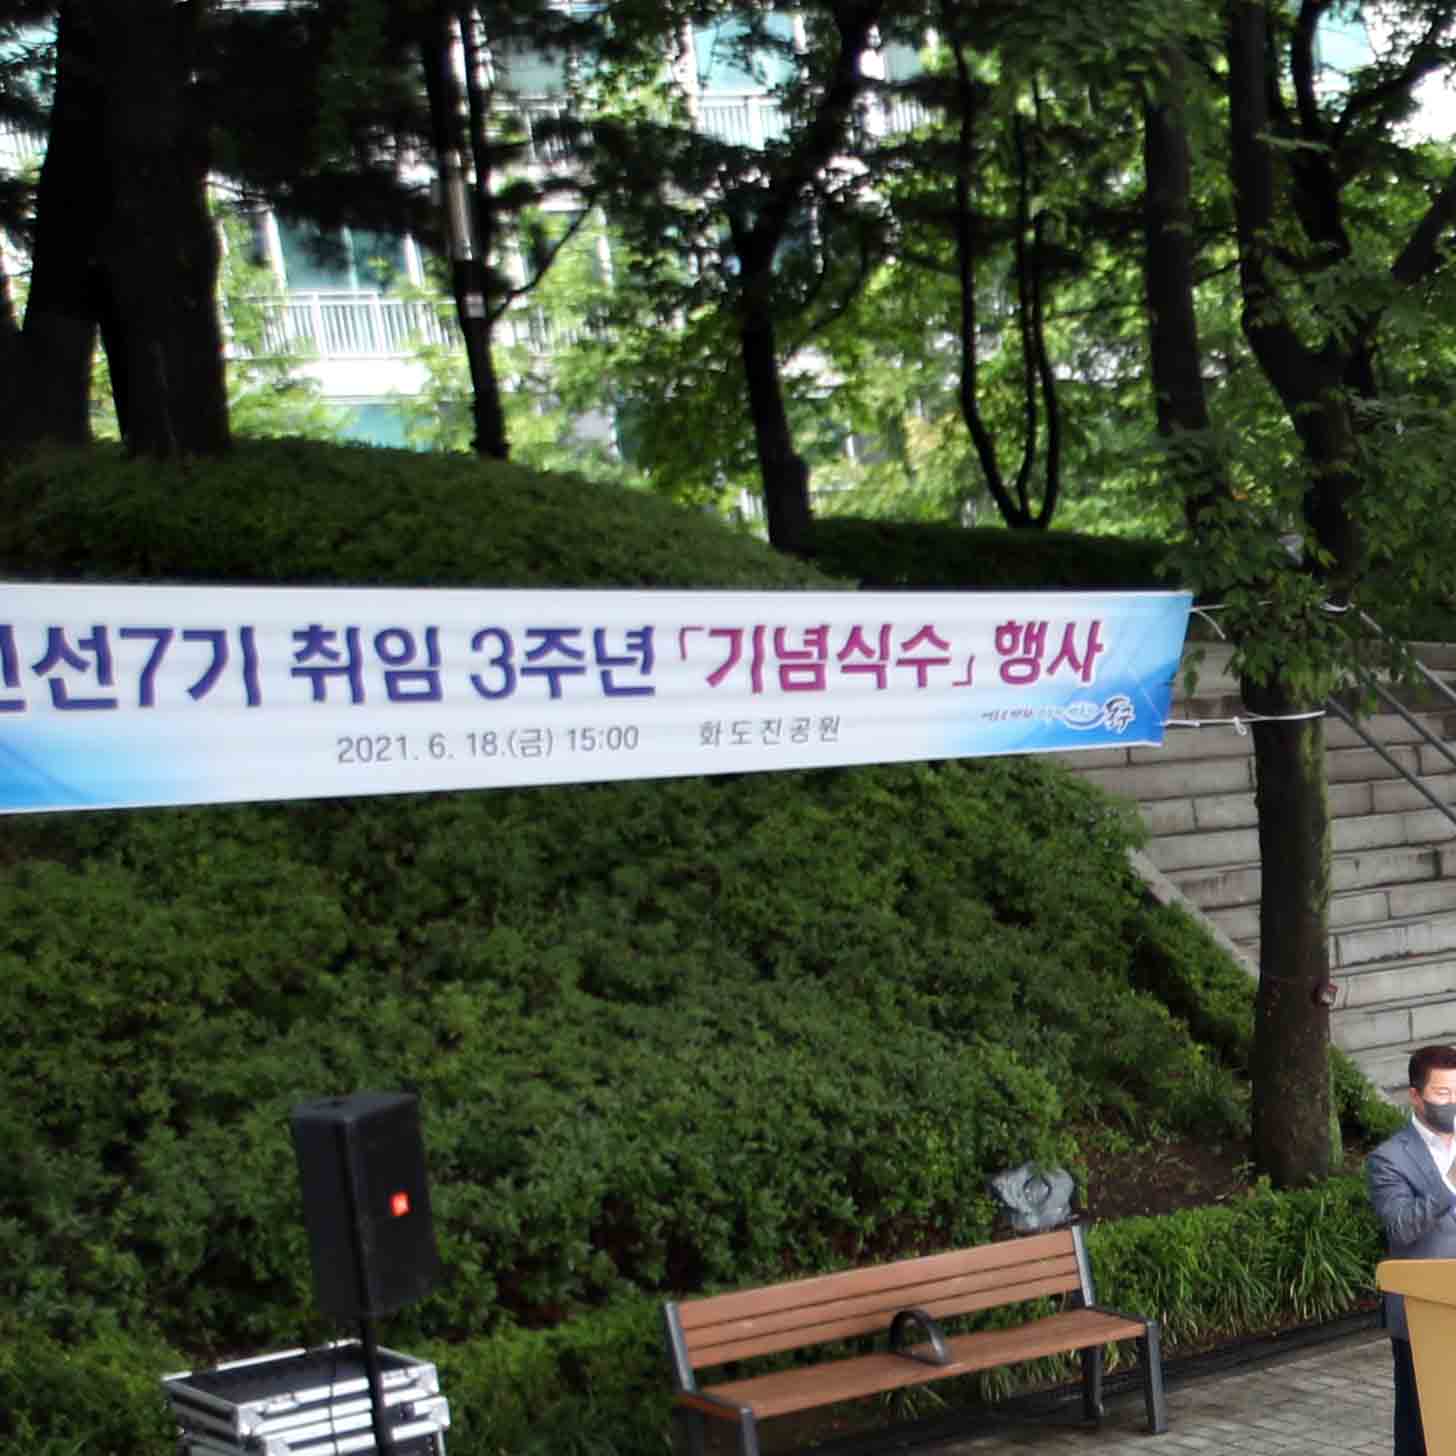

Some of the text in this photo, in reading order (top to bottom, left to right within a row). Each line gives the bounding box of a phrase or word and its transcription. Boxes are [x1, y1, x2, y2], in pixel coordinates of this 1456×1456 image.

[290, 623, 444, 705] 취임
[469, 624, 655, 701] 3주년
[679, 622, 976, 694] 「기념식수」
[994, 618, 1105, 685] 행사
[337, 714, 841, 764] 2021. 6. 18.(금) 15:00 화도진공원
